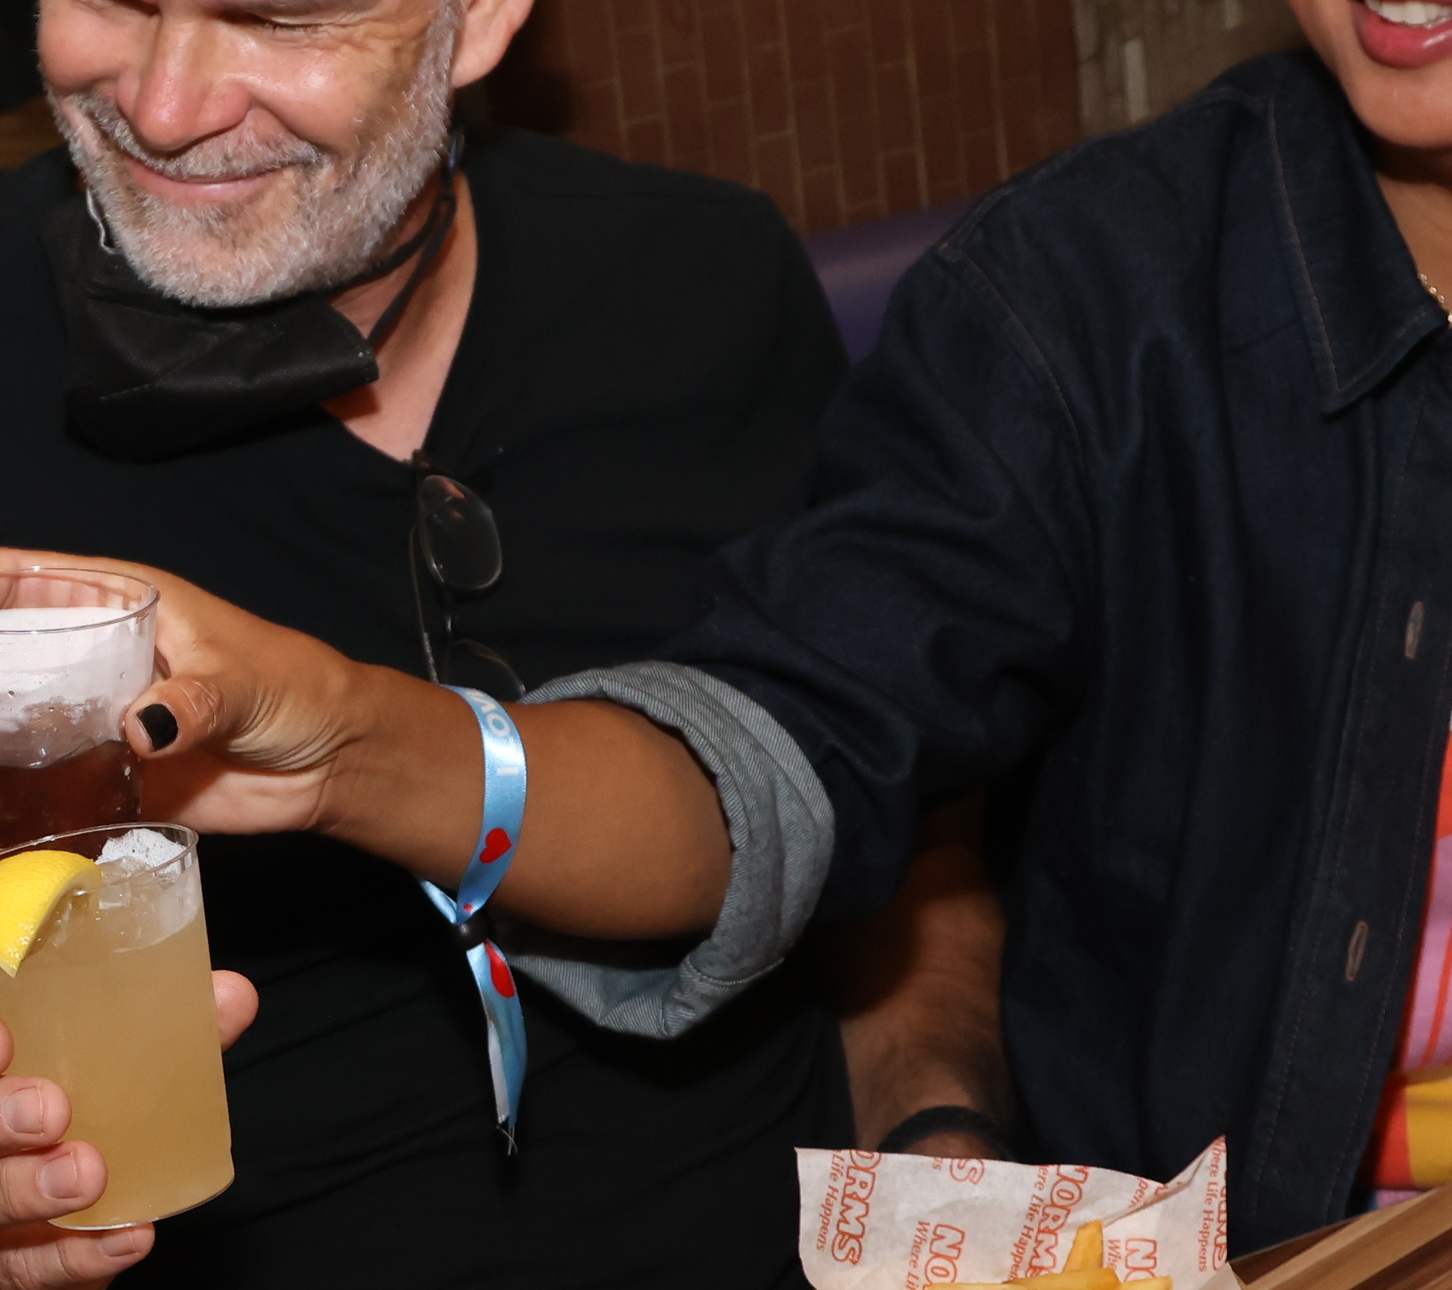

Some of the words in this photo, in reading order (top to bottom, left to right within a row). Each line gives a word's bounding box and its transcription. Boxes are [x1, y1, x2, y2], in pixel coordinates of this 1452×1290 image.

[829, 1151, 846, 1181] Life
[1034, 1165, 1049, 1190] ere
[832, 1149, 882, 1265] ORMS
[1026, 1194, 1045, 1223] Life
[1205, 1180, 1220, 1206] Life
[816, 1185, 839, 1252] Happens
[1198, 1210, 1215, 1272] Happens
[909, 1220, 930, 1269] Where
[1008, 1224, 1035, 1280] Happen
